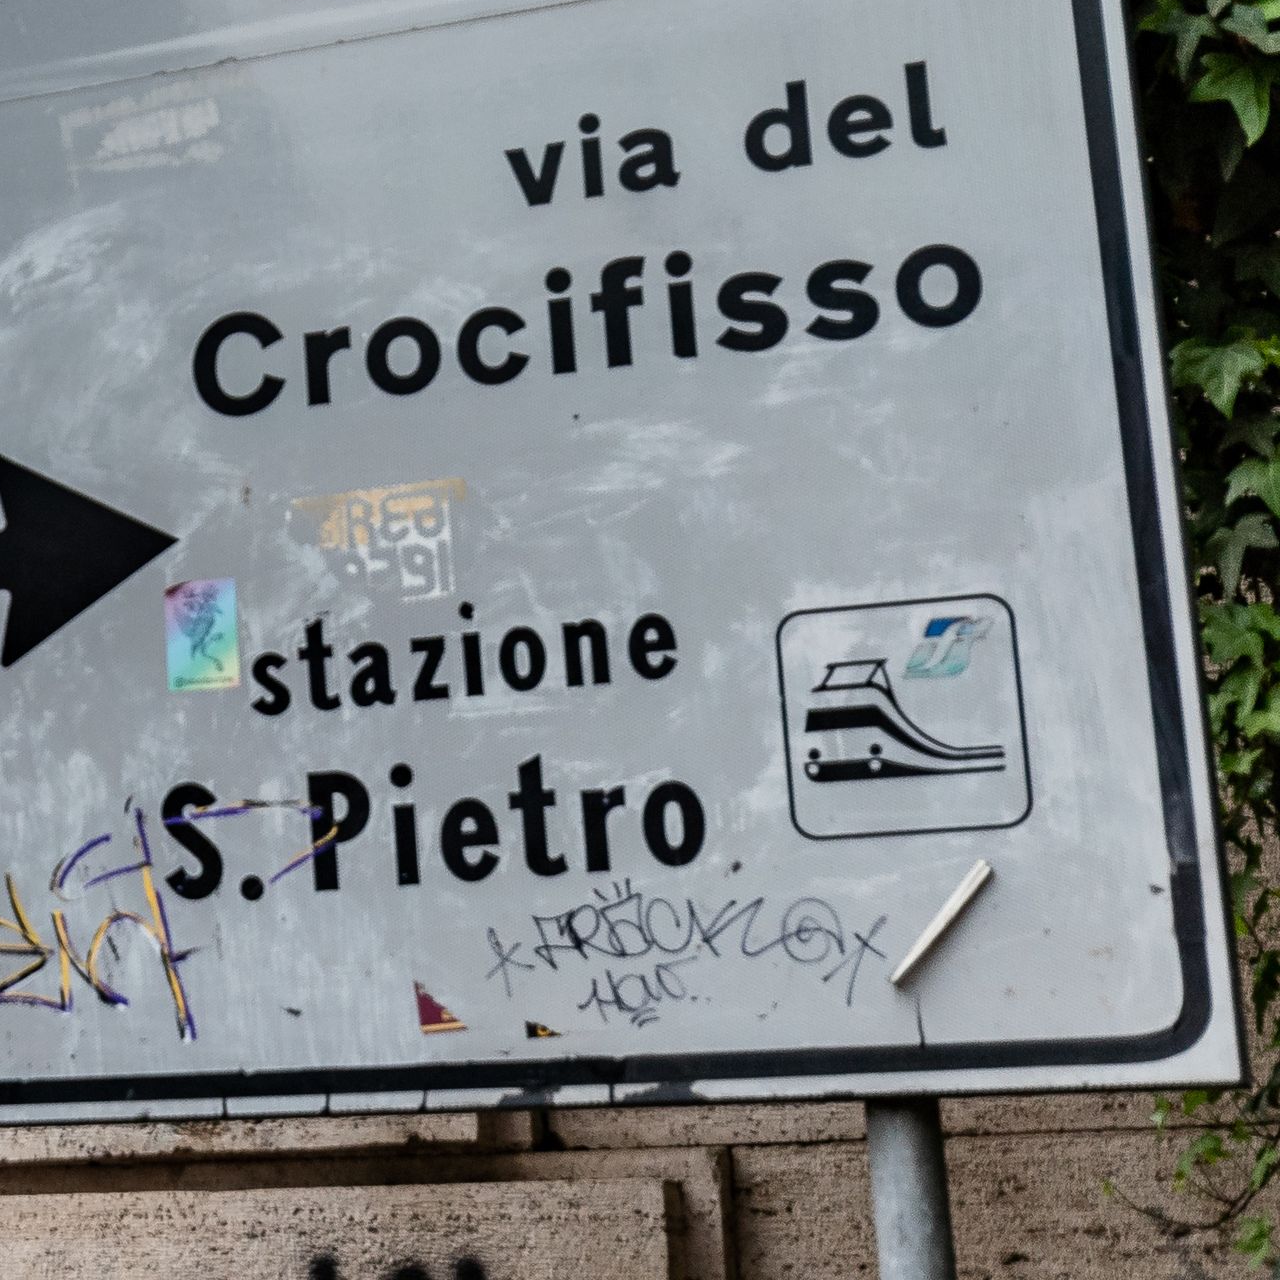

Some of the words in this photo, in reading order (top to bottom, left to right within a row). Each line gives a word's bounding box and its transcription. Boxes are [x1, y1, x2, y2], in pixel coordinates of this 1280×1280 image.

[505, 113, 680, 207] via
[744, 60, 947, 172] del
[192, 244, 983, 418] Crocifisso
[251, 601, 678, 718] stazione
[161, 782, 266, 902] S.
[307, 754, 706, 892] Pietro
